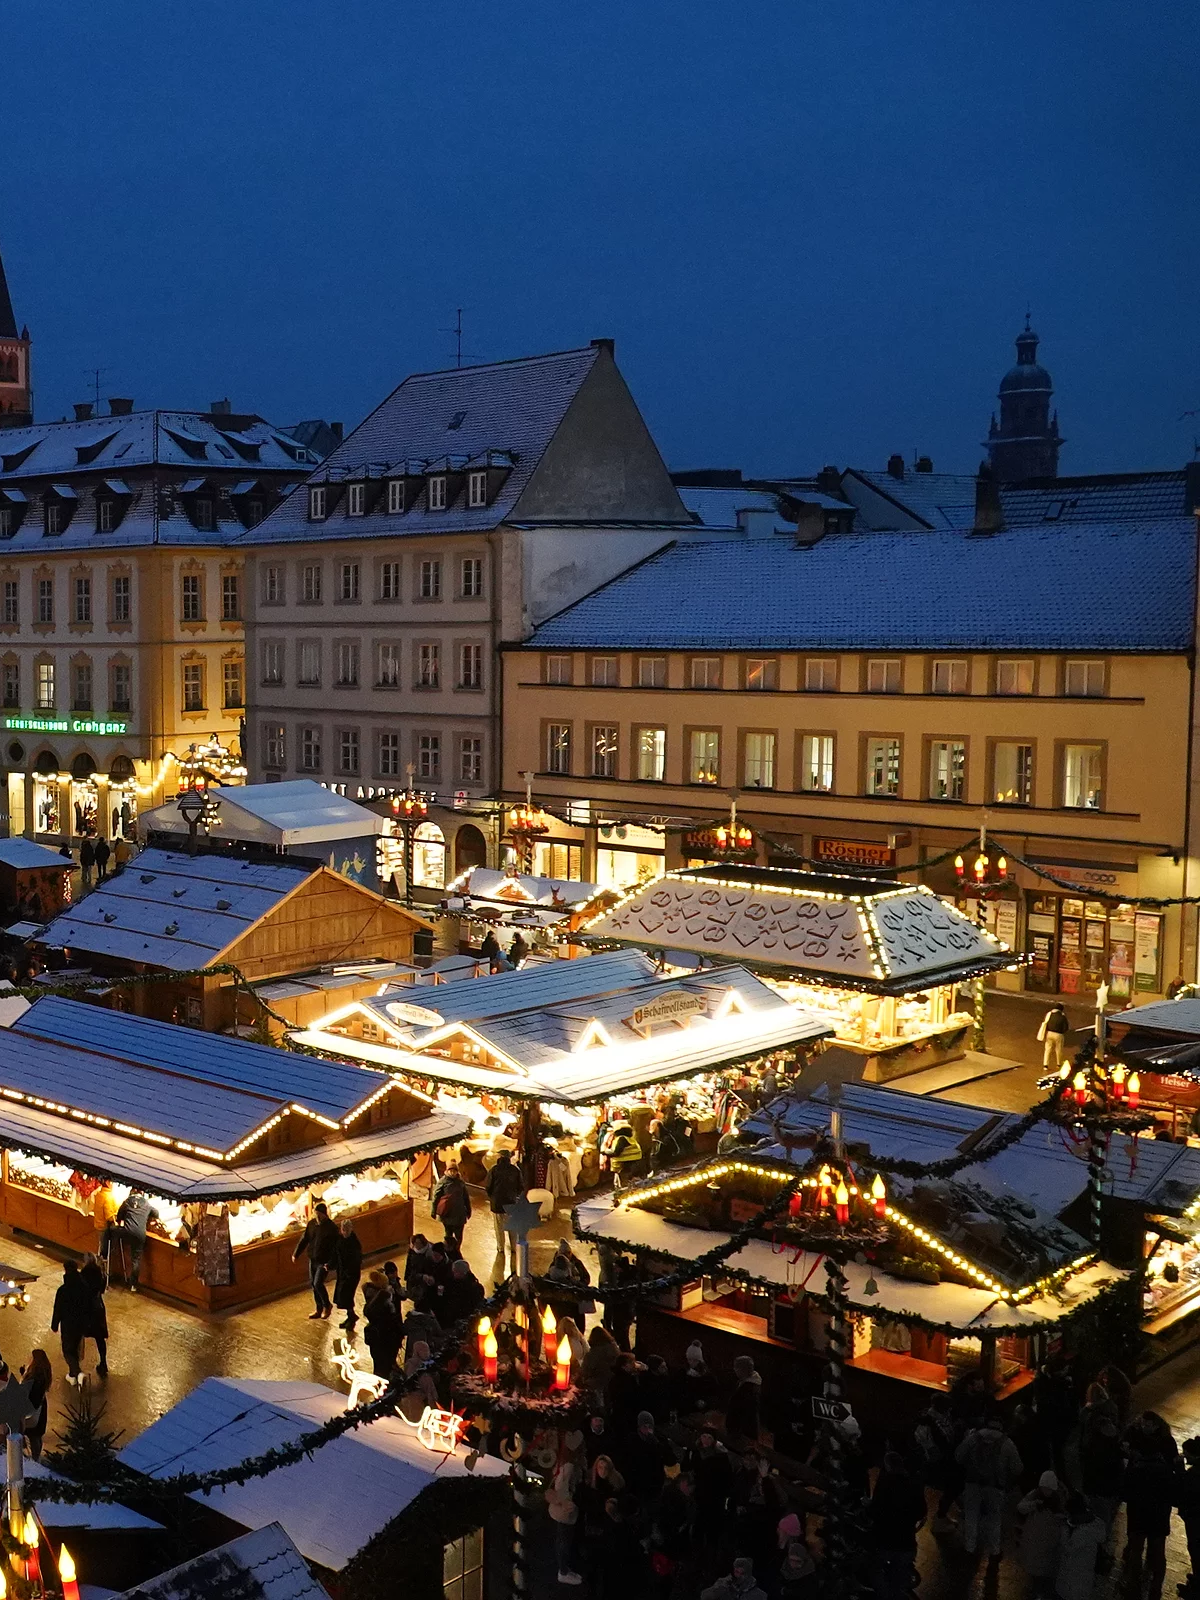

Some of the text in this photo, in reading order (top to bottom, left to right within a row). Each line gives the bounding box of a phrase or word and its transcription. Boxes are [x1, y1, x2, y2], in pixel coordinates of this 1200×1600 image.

[823, 841, 888, 859] Rösner
[822, 854, 887, 866] BACKSTUBE
[819, 1402, 839, 1418] WC
